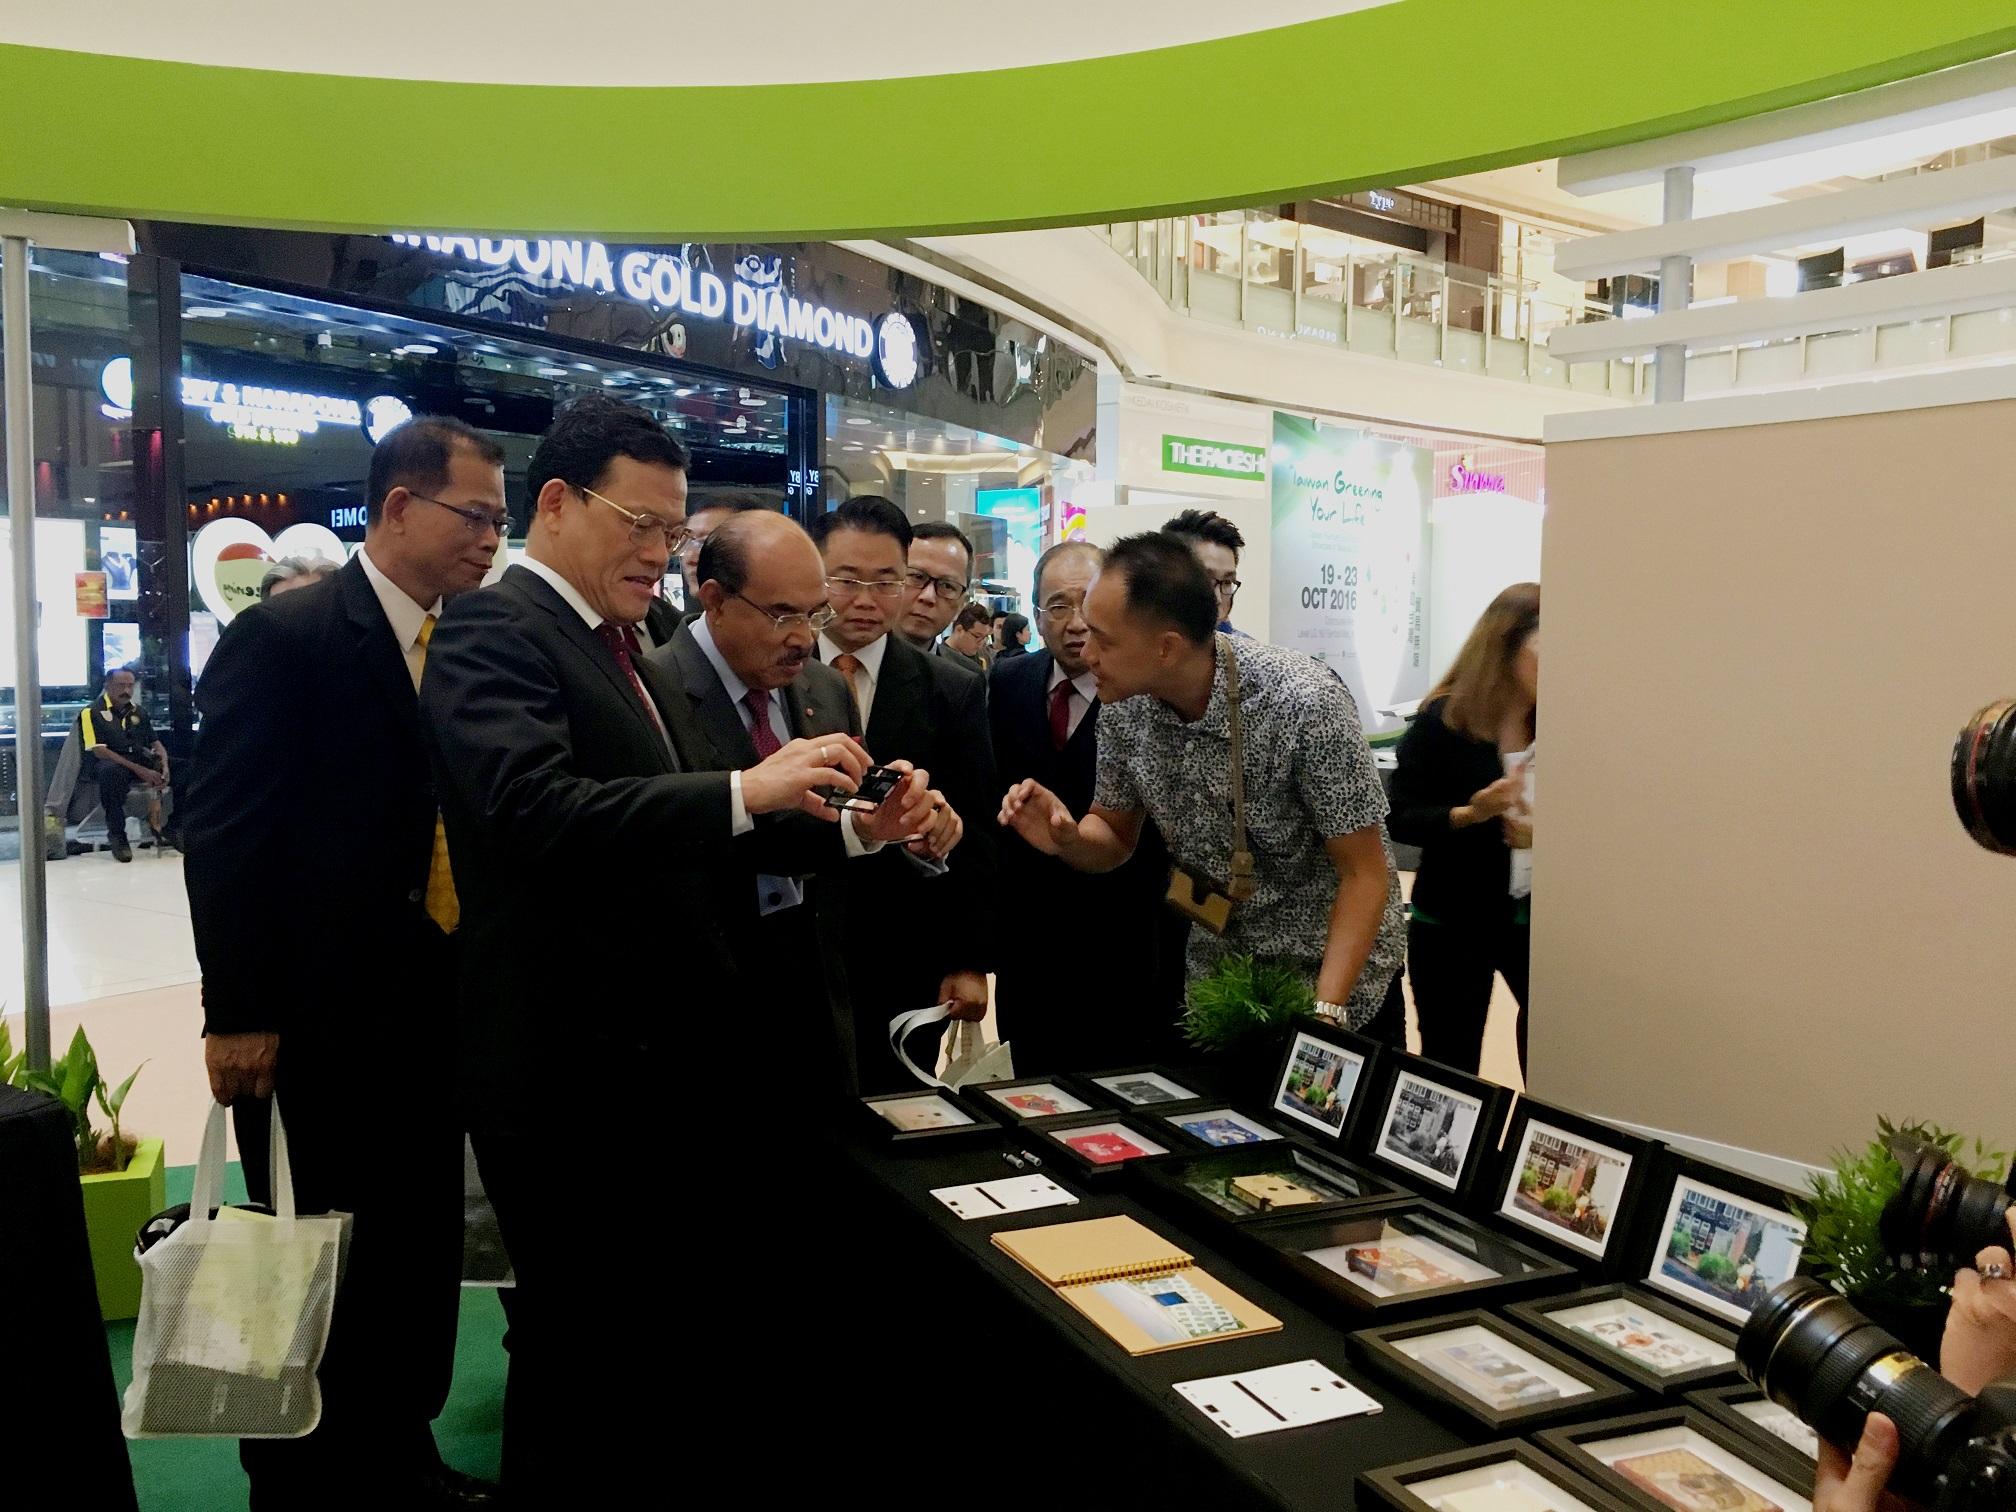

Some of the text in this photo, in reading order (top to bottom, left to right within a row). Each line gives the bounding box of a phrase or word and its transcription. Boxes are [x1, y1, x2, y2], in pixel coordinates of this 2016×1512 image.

[621, 251, 726, 318] GOLD
[732, 281, 874, 358] DIAMOND
[1334, 470, 1383, 501] Greening
[1310, 496, 1337, 521] Your
[1320, 563, 1335, 585] 19
[1344, 566, 1358, 586] 23
[1301, 586, 1357, 610] OCT 2016
